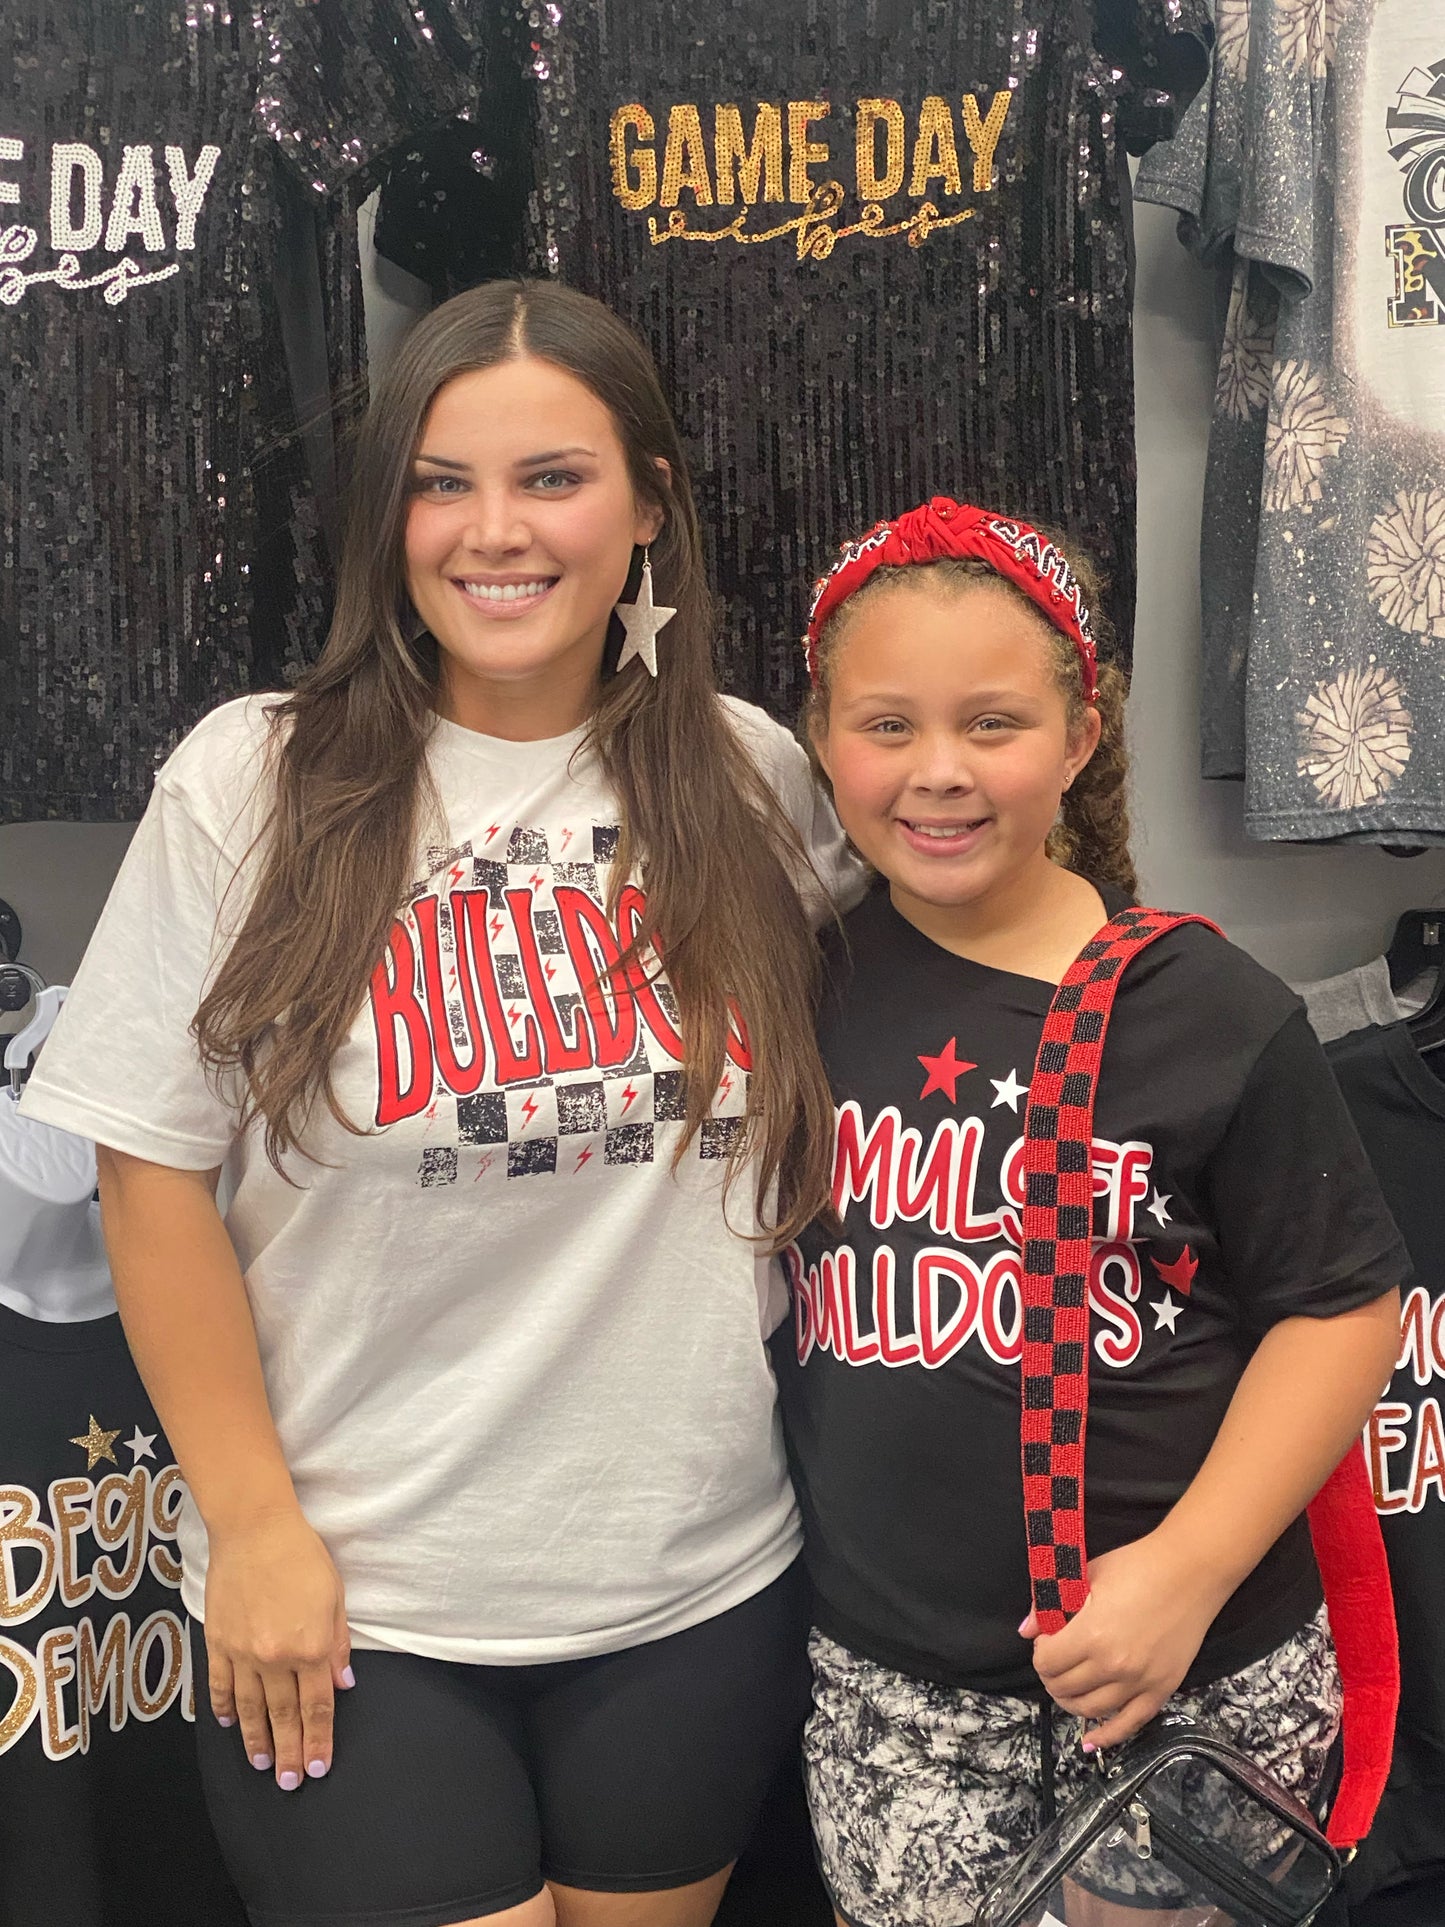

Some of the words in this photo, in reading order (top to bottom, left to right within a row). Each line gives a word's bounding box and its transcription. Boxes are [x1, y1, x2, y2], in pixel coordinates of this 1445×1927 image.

[50, 142, 222, 251] DAY
[610, 101, 830, 210] GAME
[856, 90, 1012, 201] DAY
[647, 180, 976, 260] vibes
[786, 1239, 1143, 1369] BULLDOS
